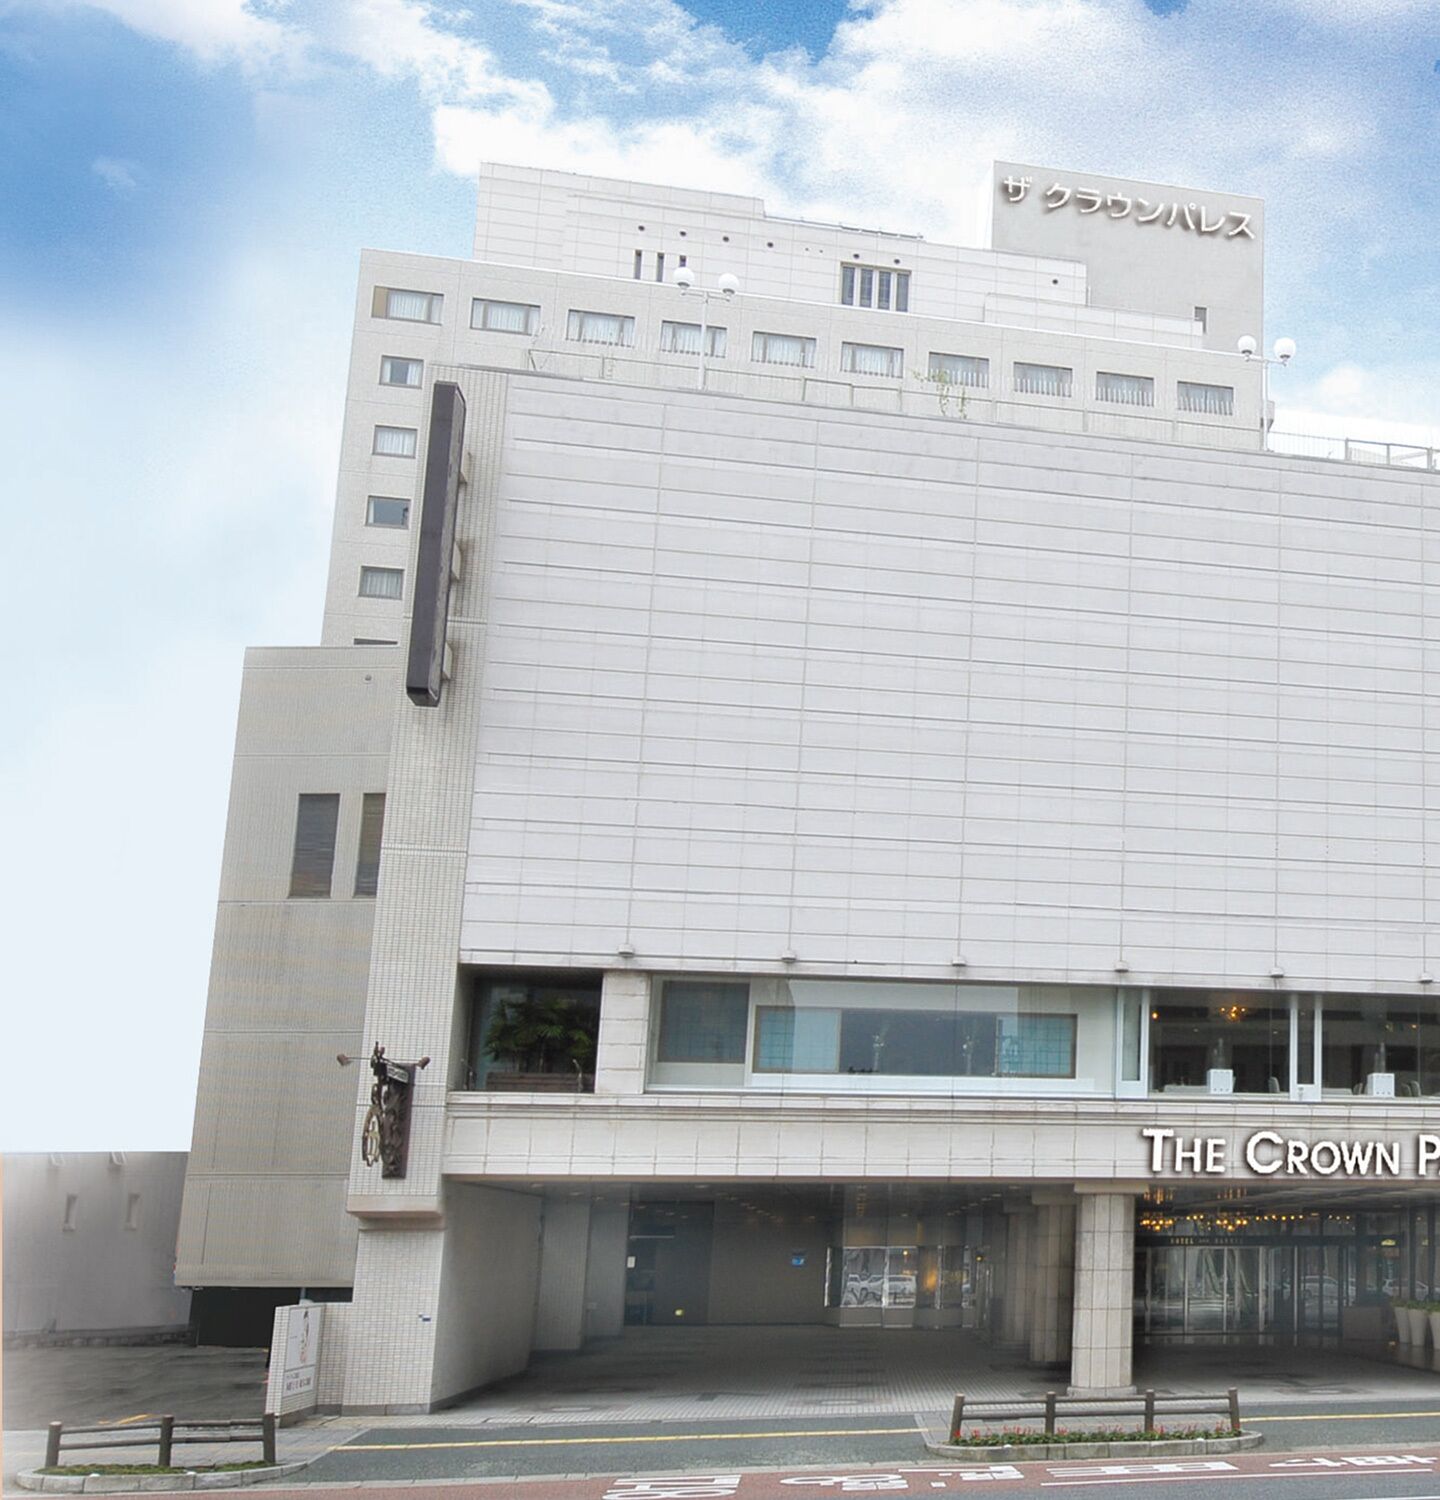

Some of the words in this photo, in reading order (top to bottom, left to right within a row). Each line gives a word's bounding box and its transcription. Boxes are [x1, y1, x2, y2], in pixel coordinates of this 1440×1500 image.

[1003, 175, 1033, 202] ザ
[1046, 182, 1255, 239] クラウンパレス
[1142, 1128, 1227, 1173] THE
[1245, 1130, 1399, 1176] CROWN
